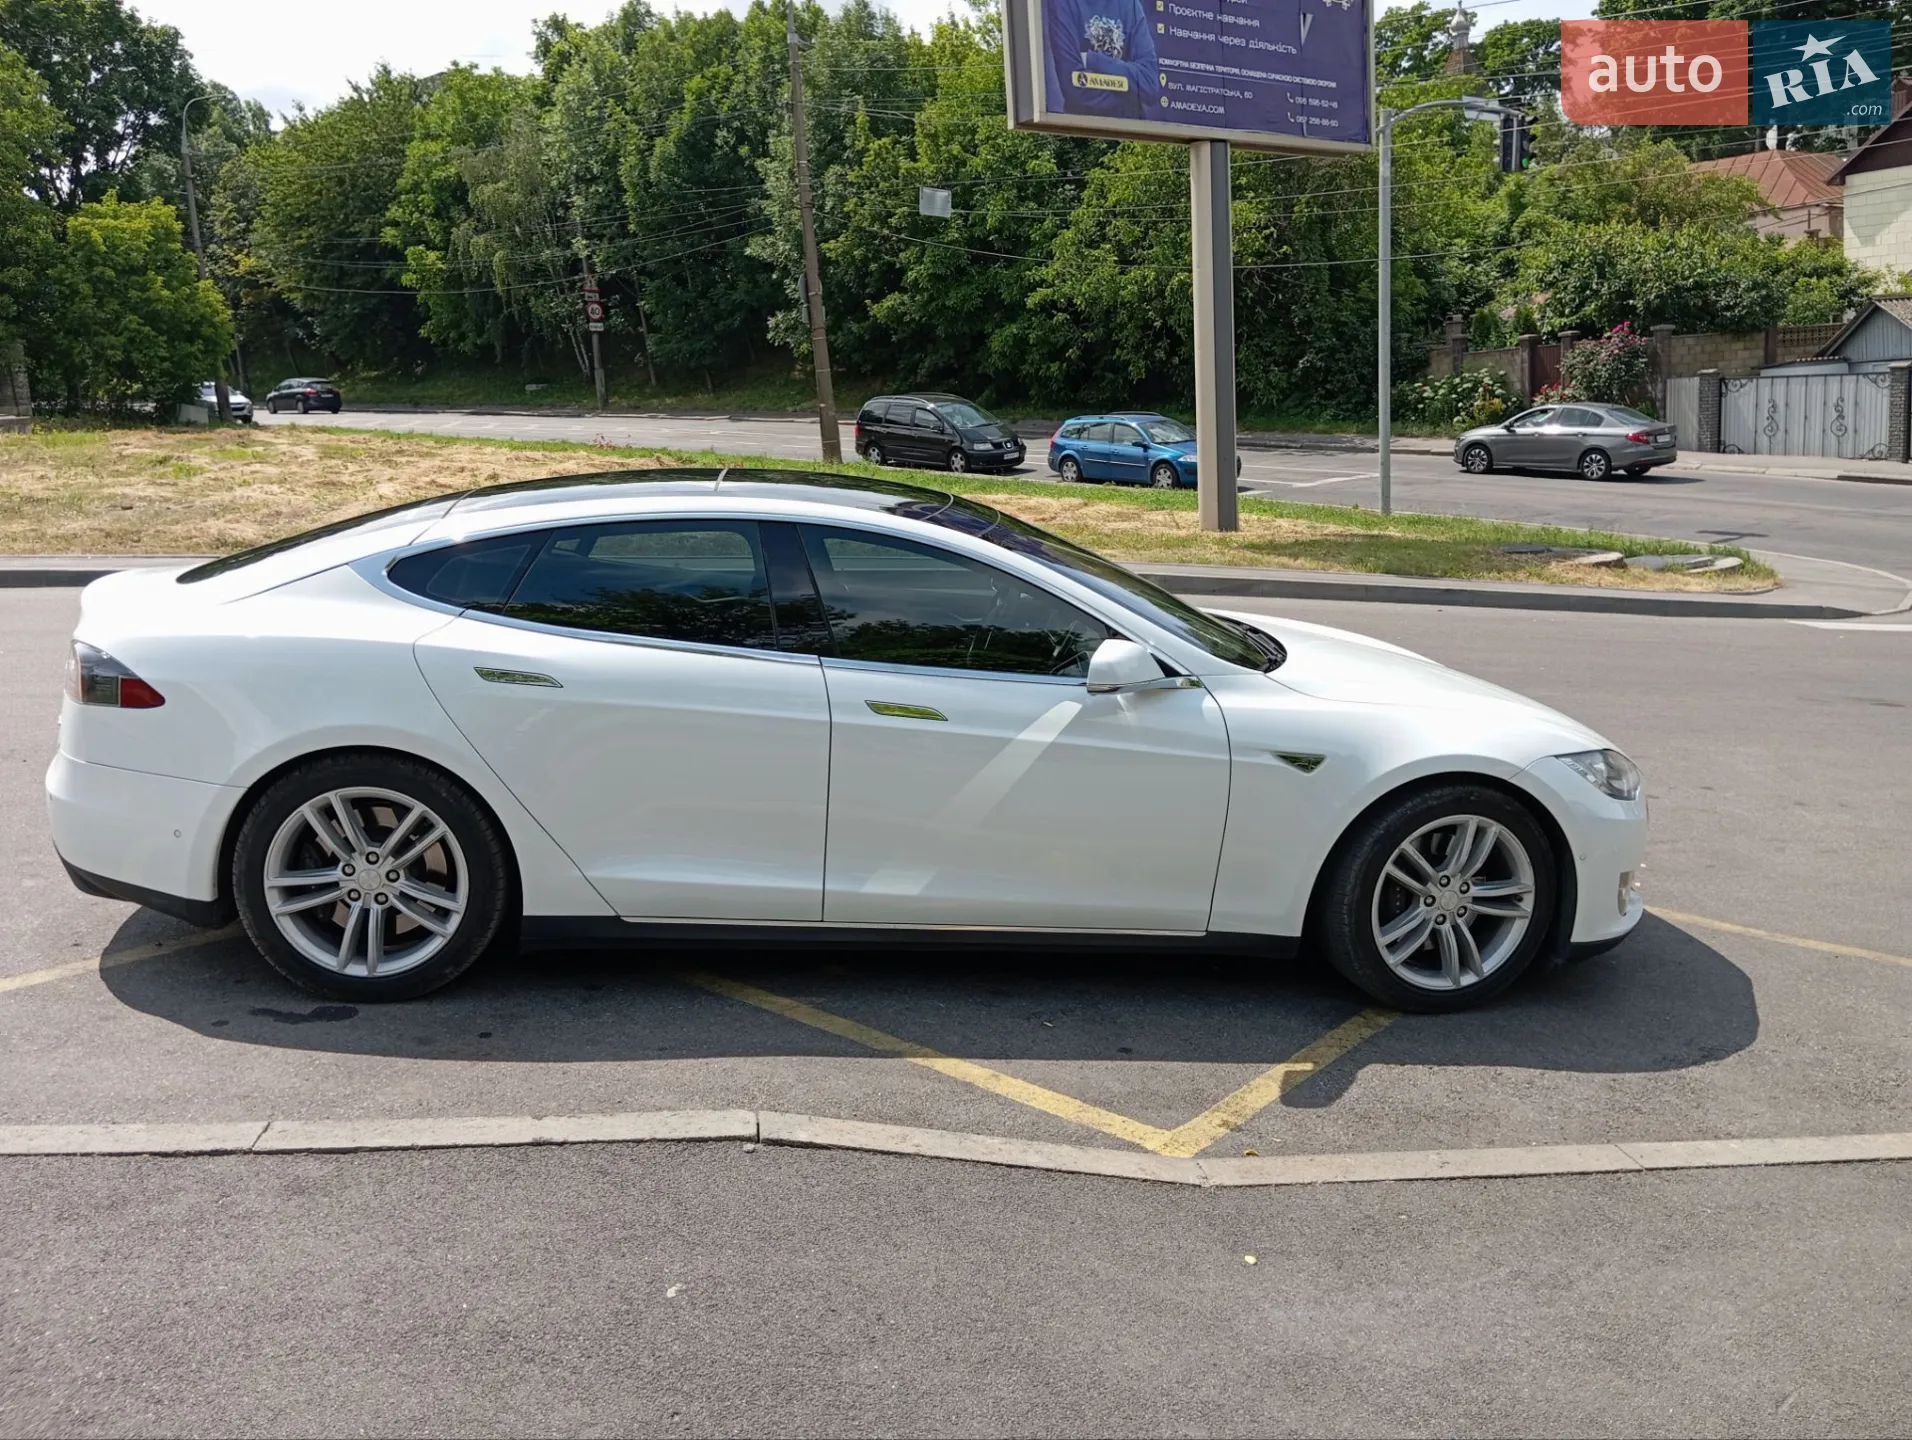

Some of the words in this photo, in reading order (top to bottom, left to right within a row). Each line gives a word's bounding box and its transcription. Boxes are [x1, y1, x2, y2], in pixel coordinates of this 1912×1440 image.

[1168, 3, 1214, 20] Проєктне
[1217, 14, 1260, 28] навчання
[1169, 25, 1216, 42] Навчання
[1218, 35, 1246, 47] через
[1249, 38, 1297, 55] діяльність
[1170, 100, 1225, 114] AMADEYA.COM
[590, 307, 601, 316] 40
